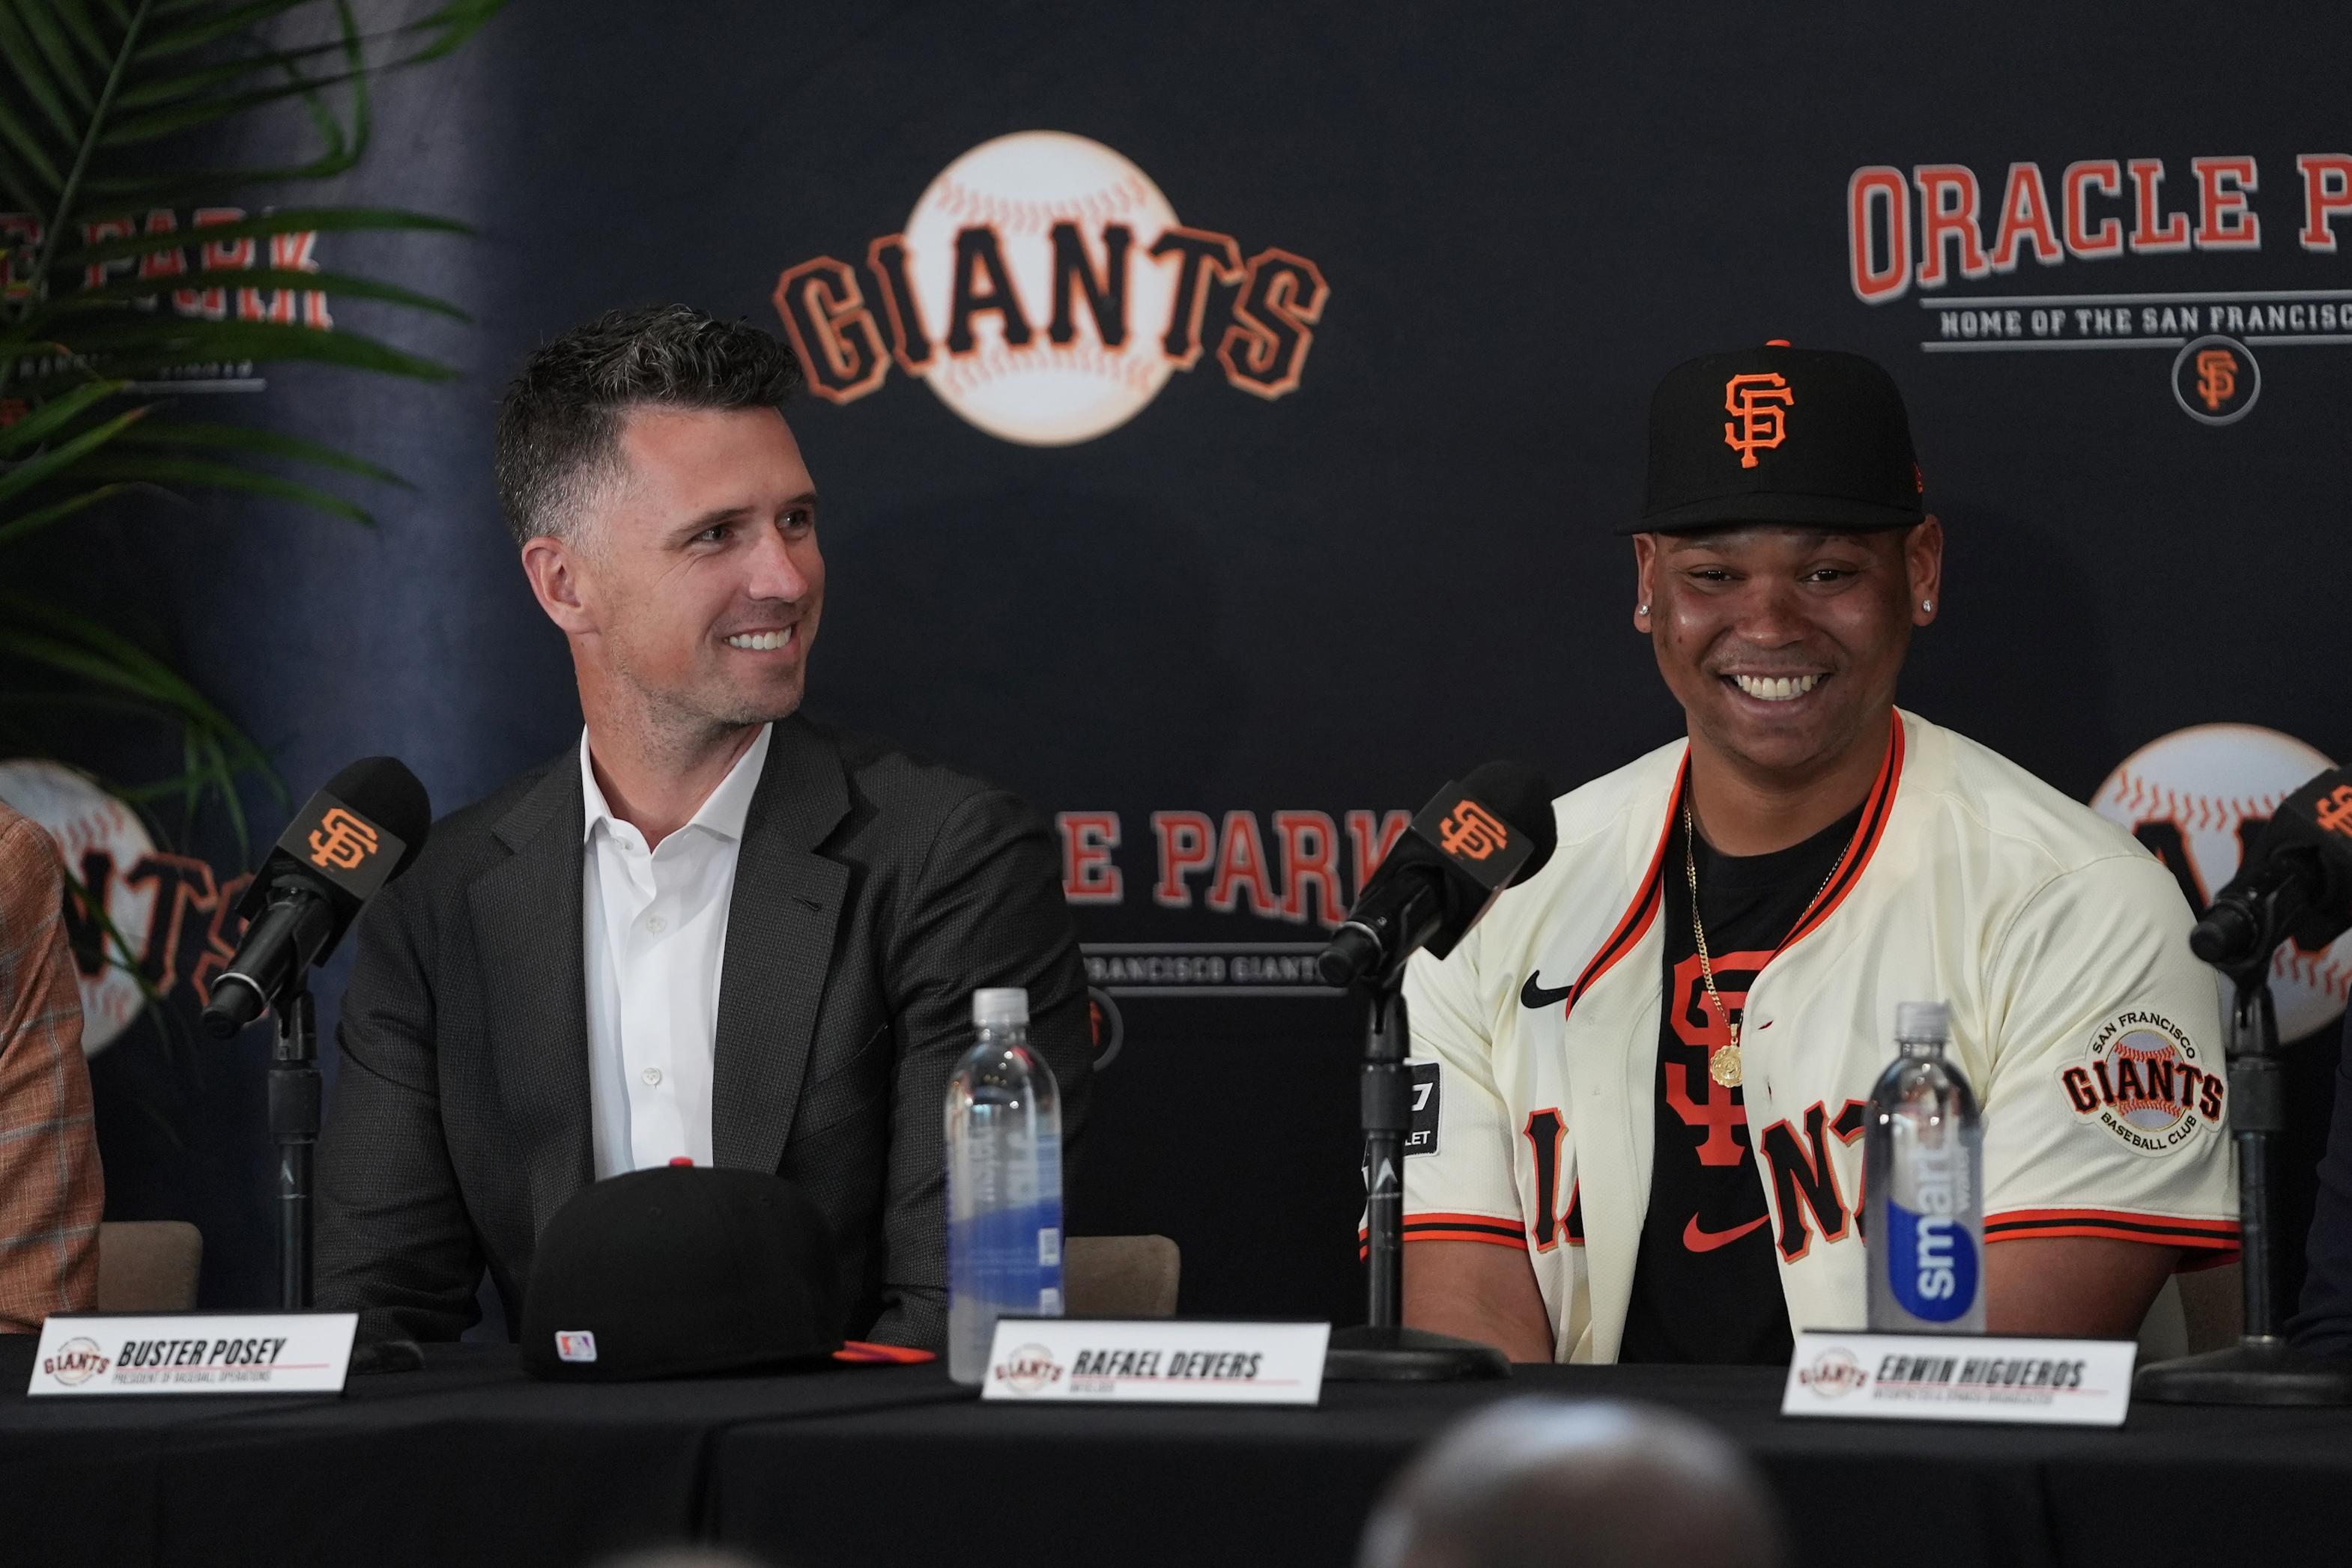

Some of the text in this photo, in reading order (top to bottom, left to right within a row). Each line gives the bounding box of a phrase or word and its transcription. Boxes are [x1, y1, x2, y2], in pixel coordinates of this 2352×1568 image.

[1847, 155, 2261, 303] ORACLE
[773, 217, 1331, 406] GIANTS
[1940, 310, 2022, 338] HOME
[2030, 309, 2067, 337] OF
[2074, 307, 2132, 336] THE
[2141, 306, 2199, 335] SAN
[1724, 371, 1795, 469] SF
[1084, 956, 1226, 984] RANCISCO
[2092, 1012, 2195, 1060] SAN FRANCISCO
[2061, 1057, 2225, 1124] GIANTS
[2100, 1111, 2197, 1150] BASEBALL CLUB
[1912, 1141, 1957, 1300] smart
[43, 1352, 110, 1375] GIANTS
[117, 1337, 287, 1367] BUSTER POSEY
[1071, 1349, 1264, 1379] RAFAEL DEVERS
[1876, 1354, 2087, 1391] ERWIN HIGUEROS
